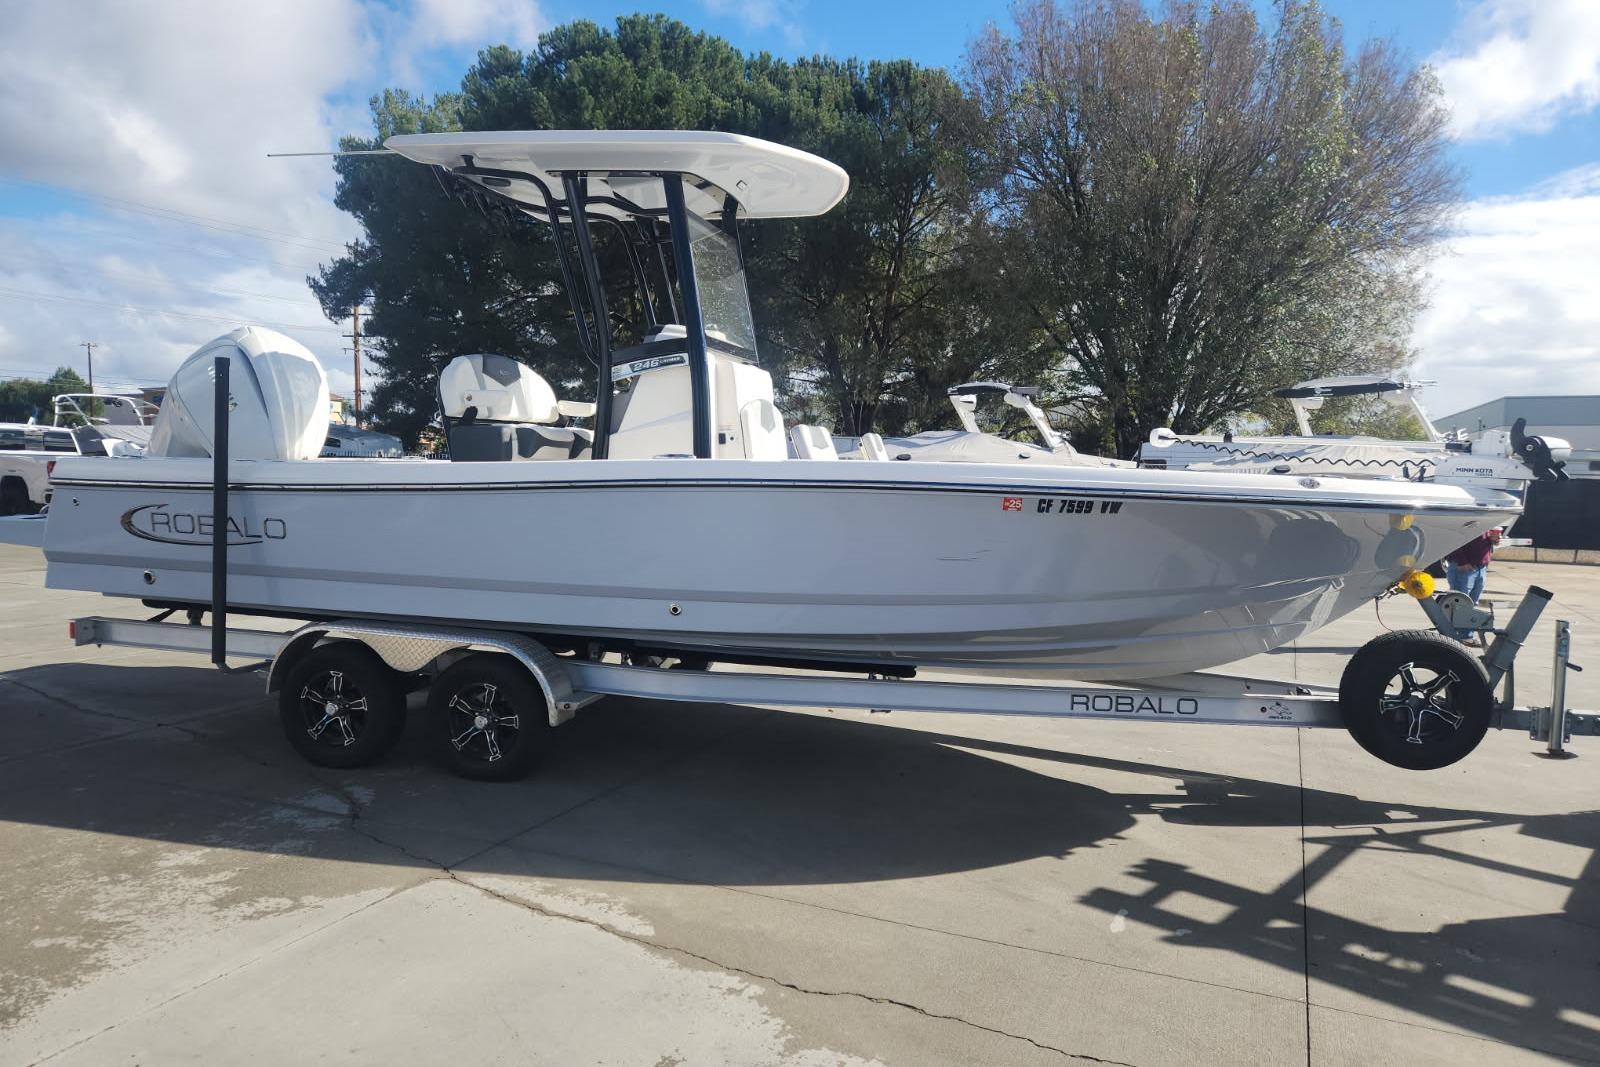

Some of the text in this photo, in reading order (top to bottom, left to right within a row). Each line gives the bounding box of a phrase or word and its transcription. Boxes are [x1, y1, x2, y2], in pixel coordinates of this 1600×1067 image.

[633, 360, 660, 372] 246
[1009, 499, 1022, 509] 25
[1037, 498, 1123, 514] CF 7599 VW
[151, 512, 287, 540] ROBALO
[1070, 694, 1199, 715] ROBALO
